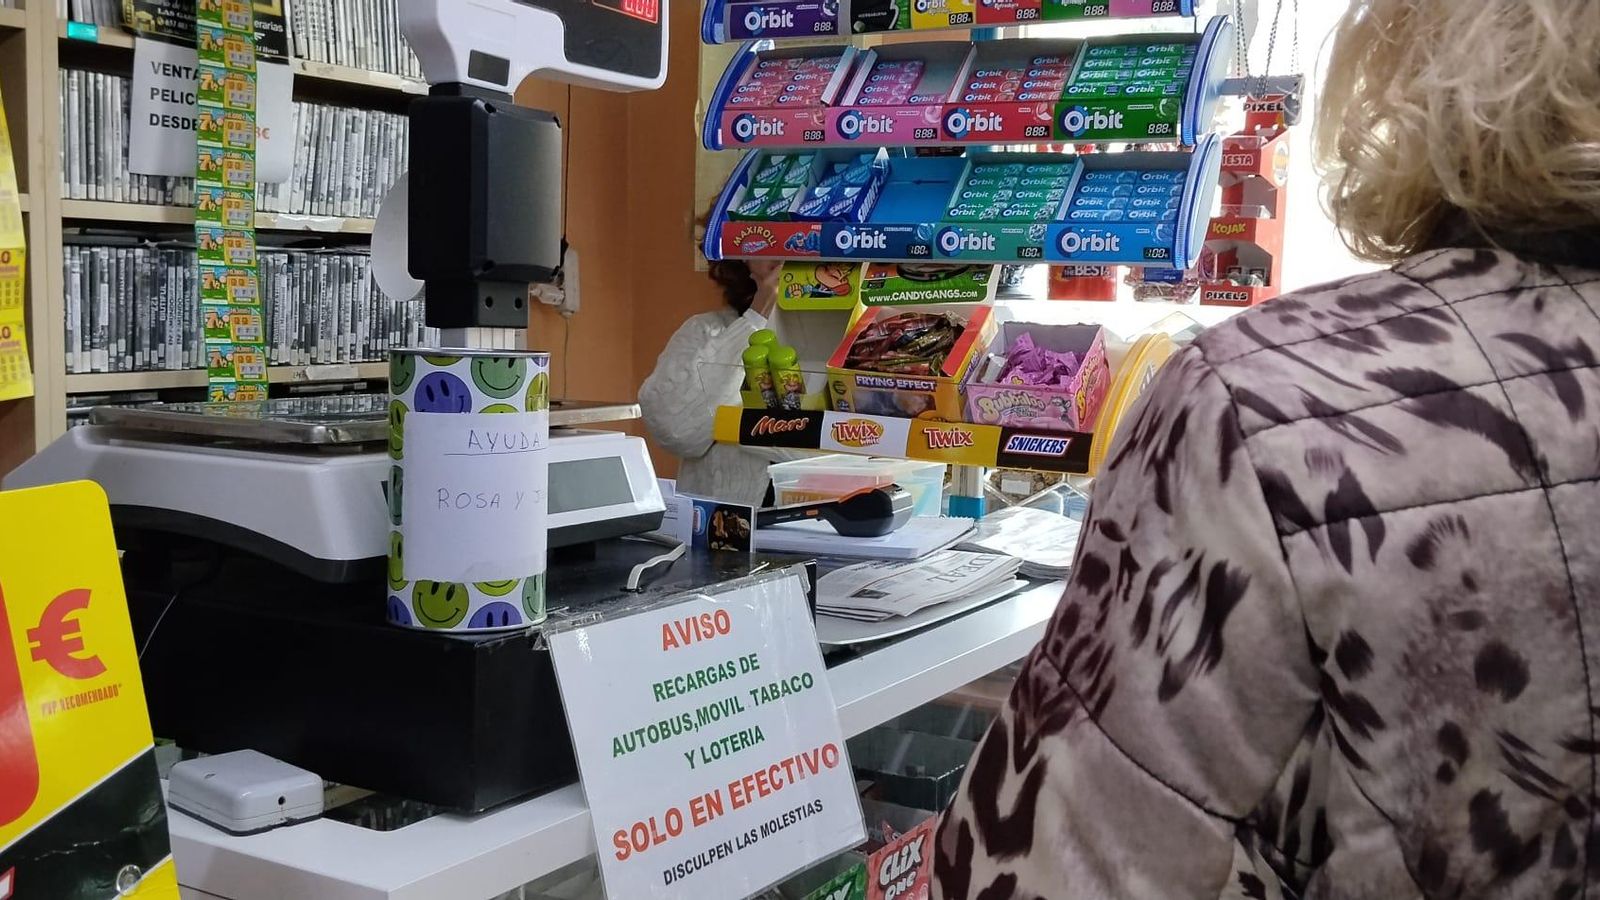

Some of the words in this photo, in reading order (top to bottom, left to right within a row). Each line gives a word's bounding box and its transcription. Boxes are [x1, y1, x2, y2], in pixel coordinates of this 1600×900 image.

[745, 9, 794, 31] Orbit
[1090, 47, 1117, 56] Orbit
[1146, 44, 1175, 54] Orbit
[1033, 57, 1060, 65] Orbit
[1084, 59, 1112, 68] Orbit
[1141, 57, 1170, 66] Orbit
[794, 73, 818, 81] Orbit
[976, 69, 1002, 78] Orbit
[1028, 69, 1055, 78] Orbit
[1079, 70, 1109, 79] Orbit
[1136, 69, 1166, 77] Orbit
[871, 74, 895, 82] Orbit
[739, 85, 762, 93] Orbit
[786, 84, 810, 92] Orbit
[970, 81, 996, 90] Orbit
[1023, 80, 1050, 89] Orbit
[1125, 84, 1155, 94] Orbit
[864, 85, 889, 94] Orbit
[1068, 85, 1097, 94] Orbit
[731, 95, 755, 104] Orbit
[779, 94, 803, 103] Orbit
[858, 96, 884, 105] Orbit
[909, 95, 934, 103] Orbit
[965, 93, 991, 102] Orbit
[1018, 92, 1045, 101] Orbit
[841, 113, 893, 135] Orbit
[947, 113, 1003, 132] Orbit
[1064, 109, 1123, 132] Orbit
[736, 116, 785, 138] Orbit
[1085, 172, 1112, 181] Orbit
[1142, 172, 1170, 181] Orbit
[969, 178, 994, 186] Orbit
[1021, 178, 1047, 186] Orbit
[1080, 185, 1109, 193] Orbit
[1137, 185, 1166, 193] Orbit
[1076, 198, 1103, 206] Orbit
[1133, 198, 1160, 206] Orbit
[949, 208, 976, 216] Orbit
[1003, 208, 1030, 216] Orbit
[1070, 211, 1098, 219] Orbit
[1129, 210, 1157, 219] Orbit
[1212, 221, 1247, 234] KOJAK
[733, 225, 778, 248] MAXIROLL
[835, 229, 887, 250] Orbit
[941, 230, 996, 251] Orbit
[1061, 232, 1120, 253] Orbit
[1205, 290, 1249, 301] PIXELS
[855, 375, 897, 386] FRYING
[897, 379, 937, 391] EFFECT
[750, 415, 810, 437] Mars
[833, 421, 880, 442] Twix
[468, 429, 540, 452] AYUDA
[924, 427, 974, 448] Twix
[1007, 436, 1068, 454] SNICKERS
[437, 487, 501, 511] ROSA
[662, 609, 732, 651] AVISO
[652, 660, 737, 703] RECARGAS
[739, 653, 761, 675] DE
[749, 672, 815, 707] TABACO
[684, 749, 697, 770] Y
[701, 725, 766, 765] LOTERIA
[613, 807, 685, 862] SOLO
[689, 789, 725, 827] EN
[728, 742, 841, 810] EFECTIVO
[663, 840, 734, 886] DISCULPEN
[735, 829, 759, 851] LAS
[760, 799, 824, 839] MOLESTIAS
